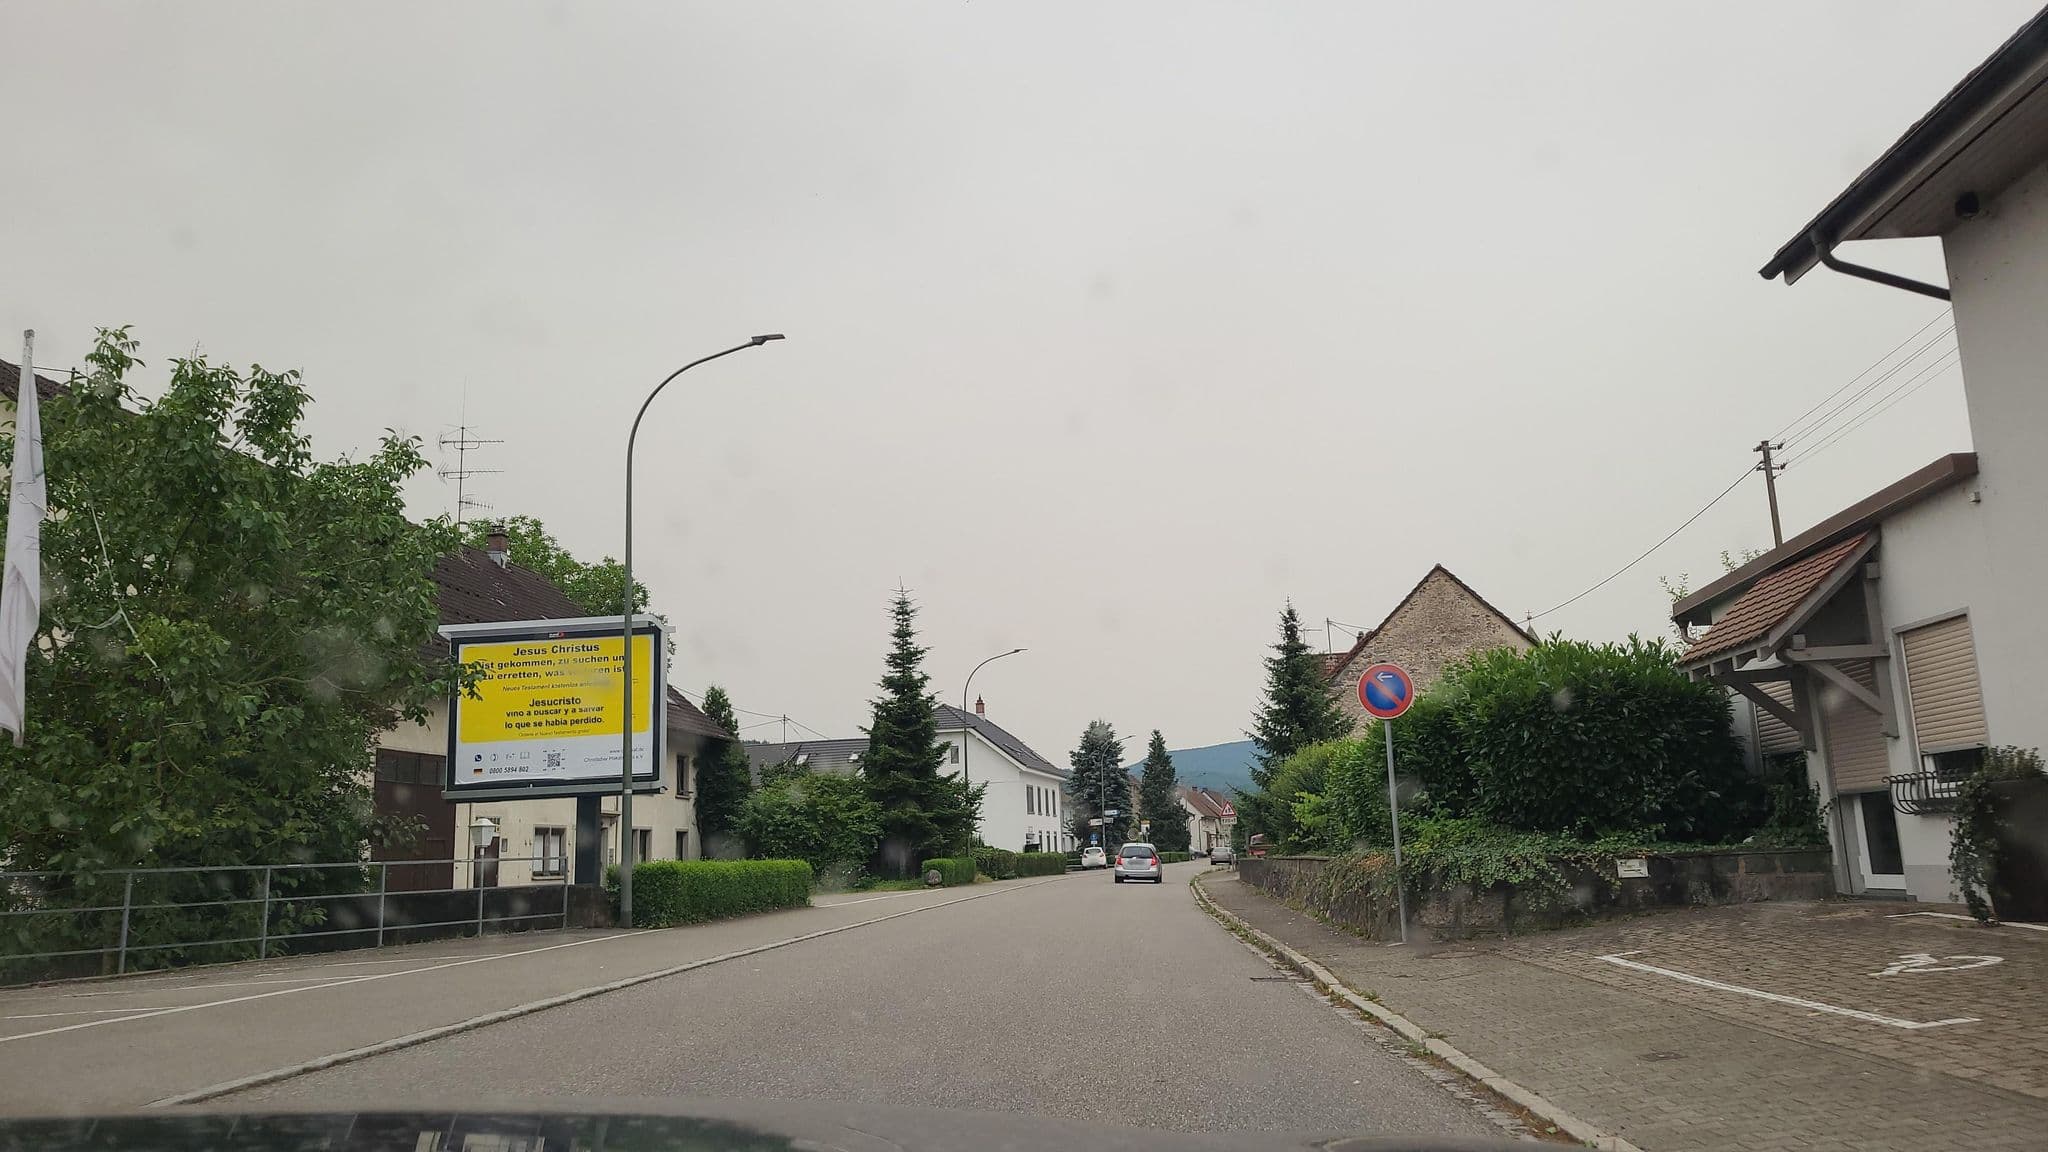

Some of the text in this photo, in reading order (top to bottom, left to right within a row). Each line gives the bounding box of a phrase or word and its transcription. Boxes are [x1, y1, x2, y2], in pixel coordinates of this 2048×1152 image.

[513, 643, 600, 656] Jesus Christus
[497, 659, 556, 670] gekommen,
[572, 655, 609, 664] suchen
[497, 671, 542, 680] erretten,
[529, 696, 581, 707] Jesucristo
[505, 721, 513, 729] lo
[515, 721, 531, 730] que
[533, 720, 543, 728] se
[570, 715, 605, 726] perdido.
